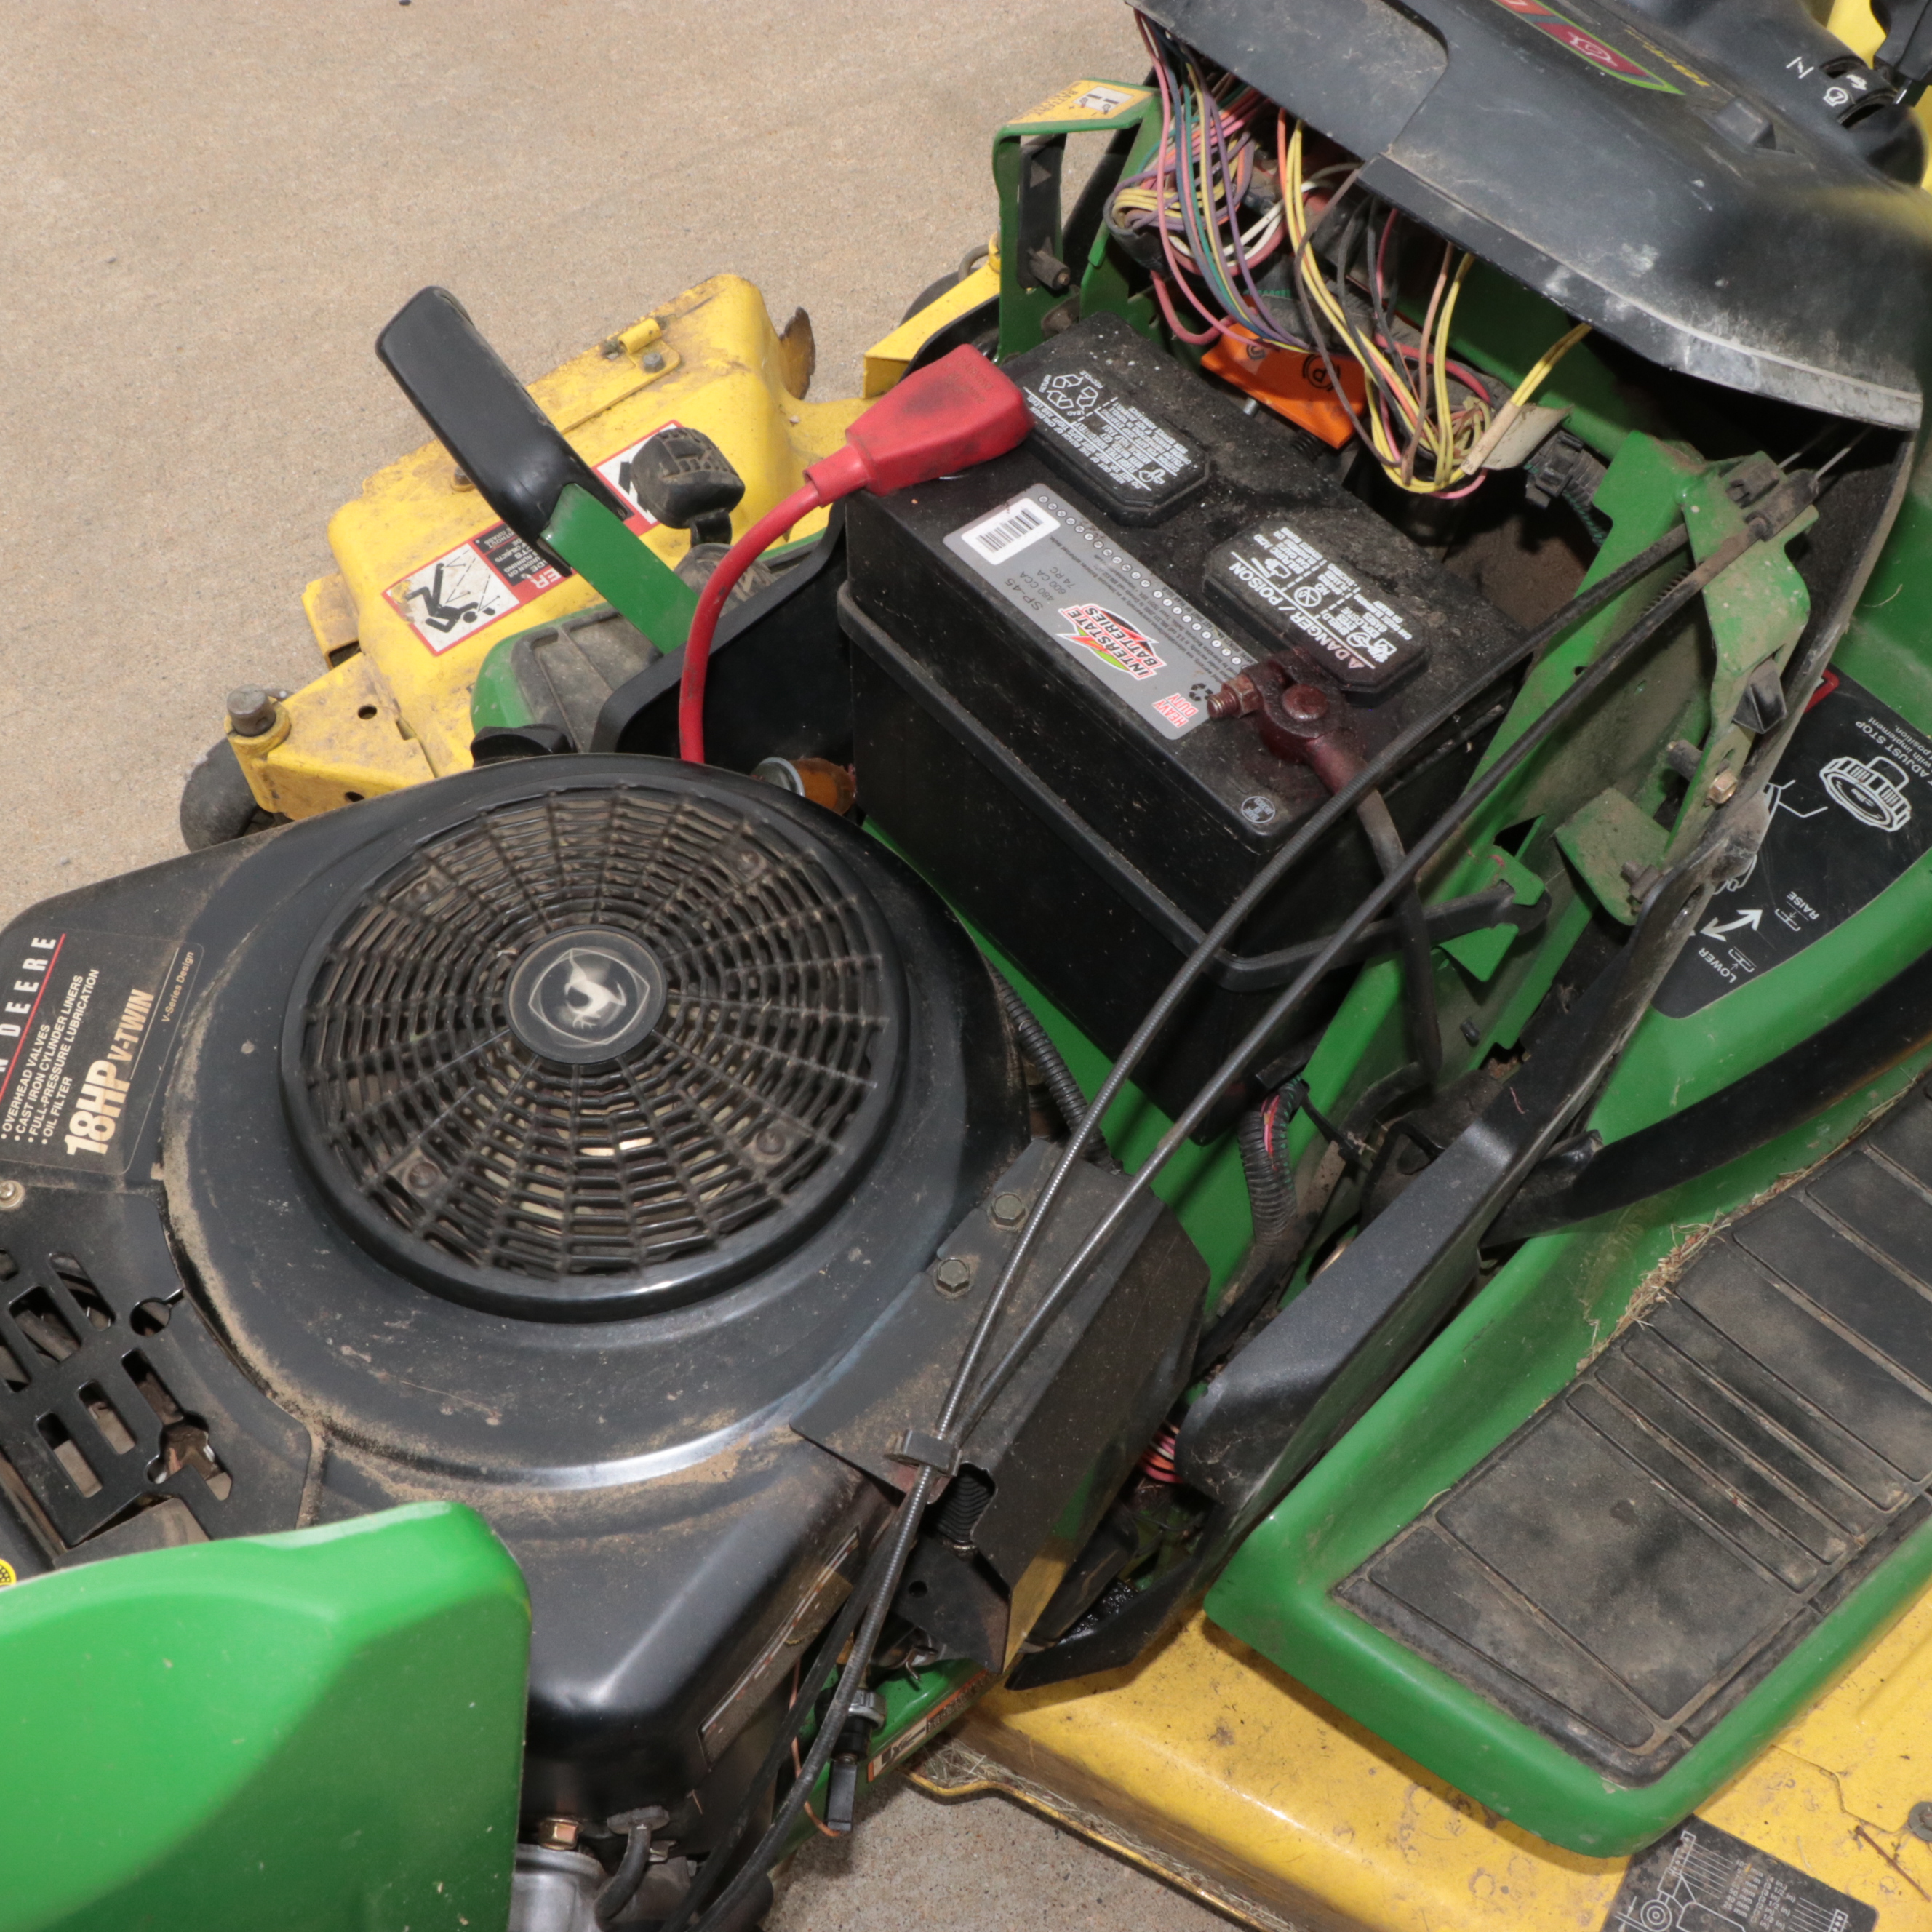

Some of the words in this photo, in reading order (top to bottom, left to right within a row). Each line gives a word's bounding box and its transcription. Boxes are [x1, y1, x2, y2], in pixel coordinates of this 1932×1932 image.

[1034, 89, 1079, 116] BATTERY
[1039, 374, 1052, 393] RETURN
[1079, 370, 1103, 389] RECYCLE
[1029, 405, 1056, 427] CHILDREN
[1040, 407, 1054, 418] AND
[1100, 408, 1125, 428] STARTING
[1107, 406, 1129, 423] VEHICLE
[1111, 401, 1137, 422] AVAILABLE
[1051, 415, 1069, 431] TIGHT
[1053, 425, 1064, 434] OF
[1101, 423, 1118, 436] FAST
[1134, 420, 1147, 430] NOT
[1061, 431, 1082, 447] REACH
[1067, 428, 1084, 442] CAPS
[1073, 420, 1109, 450] IMMEDIATELY
[1098, 432, 1113, 443] GET
[1114, 434, 1131, 447] HELP
[1122, 426, 1138, 439] JUMP
[1131, 426, 1166, 454] INSTRUCTIONS
[1154, 427, 1176, 444] SERVICE
[1079, 446, 1092, 456] THE
[1081, 440, 1098, 453] VENT
[1134, 436, 1149, 448] SAFE
[1146, 446, 1159, 456] FOR
[1172, 442, 1189, 454] SEEK
[1088, 454, 1101, 463] OF
[1094, 450, 1111, 464] KEEP
[1104, 447, 1122, 460] EYES
[1127, 444, 1152, 464] MEDICAL
[1128, 455, 1145, 468] WITH
[1162, 450, 1184, 468] FOLLOW
[1097, 461, 1112, 473] OUT
[1117, 457, 1138, 473] FLUSH
[1109, 471, 1125, 484] KEEP
[1119, 471, 1133, 482] NOT
[1130, 480, 1142, 489] DO
[483, 530, 507, 545] GRASS
[1251, 532, 1274, 549] ACID
[1272, 530, 1286, 540] OR
[1278, 526, 1303, 544] BURNS
[493, 545, 522, 562] OBJECTS
[1275, 541, 1299, 559] CAUSE
[1282, 538, 1317, 564] BLINDNESS
[1298, 541, 1324, 560] SEVERE
[503, 554, 533, 573] RUNNING
[517, 556, 541, 571] UNDER
[1268, 546, 1306, 574] SULFURIC
[1295, 556, 1312, 568] CAN
[507, 569, 519, 578] OR
[1017, 570, 1039, 588] CCA
[1034, 569, 1051, 581] CA
[1047, 565, 1064, 579] RC
[1322, 570, 1351, 590] FLAMES
[1325, 562, 1357, 586] SMOKING
[1047, 580, 1067, 595] 600
[1061, 576, 1077, 588] 74
[1228, 561, 1284, 605] POISON
[1313, 581, 1332, 595] NO
[1314, 573, 1344, 595] SPARKS
[1003, 577, 1044, 611] SP-45
[1035, 586, 1055, 602] 480
[1173, 596, 1186, 607] YEAR
[1352, 593, 1385, 617] BLINDNESS
[1371, 599, 1396, 617] INJURY
[1158, 609, 1171, 620] Texas
[1334, 612, 1358, 630] EYES
[1339, 606, 1382, 638] EXPLOSIVE
[1361, 611, 1389, 632] GASES
[1380, 615, 1401, 631] CAUSE
[1392, 614, 1403, 623] OR
[1320, 612, 1352, 636] SHIELD
[1066, 607, 1149, 677] INTERSTATE
[1084, 605, 1159, 668] BATTERIES
[1288, 610, 1351, 660] DANGER
[1397, 628, 1413, 639] CAN
[1151, 697, 1189, 727] HEAVY
[1165, 691, 1198, 718] DUTY
[1854, 718, 1887, 746] STOP
[1867, 715, 1914, 754] implement
[1892, 724, 1931, 757] position.
[1884, 741, 1930, 780] ADJUST
[1912, 751, 1932, 769] with
[1254, 797, 1274, 815] MEXICO
[1786, 890, 1819, 920] RAISE
[1696, 946, 1737, 983] LOWER
[0, 937, 56, 1037] DEERE
[161, 984, 182, 1022] V-Series
[175, 951, 196, 982] Design
[15, 1102, 35, 1133] CAST
[27, 1072, 47, 1101] IRON
[38, 1015, 68, 1071] CYLINDER
[59, 975, 84, 1014] LINERS
[28, 1044, 71, 1135] FULL-PRESSURE
[63, 969, 100, 1042] LUBRICATION
[1, 1069, 33, 1132] OVERHEAD
[25, 1024, 50, 1066] VALVES
[64, 1060, 131, 1155] 18HP
[107, 989, 154, 1061] V-TWIN
[42, 1118, 57, 1137] OIL
[50, 1077, 73, 1116] FILTER
[1744, 1880, 1758, 1890] mm
[1760, 1888, 1770, 1897] (3
[1769, 1893, 1781, 1903] in)
[1763, 1881, 1772, 1890] (3
[1773, 1886, 1785, 1896] 1/2
[1784, 1893, 1797, 1903] in)
[1728, 1888, 1739, 1896] 50
[1739, 1893, 1753, 1904] mm
[1755, 1901, 1764, 1910] (2
[1763, 1906, 1775, 1916] in)
[1741, 1887, 1756, 1897] mm
[1757, 1895, 1767, 1904] (2
[1767, 1900, 1780, 1910] 1/2
[1779, 1906, 1791, 1917] in)
[1723, 1901, 1733, 1910] 25
[1733, 1907, 1748, 1918] mm
[1758, 1920, 1770, 1930] in)
[1725, 1894, 1736, 1903] 40
[1736, 1900, 1750, 1911] mm
[1762, 1913, 1774, 1923] 1/2
[1774, 1920, 1786, 1930] in)
